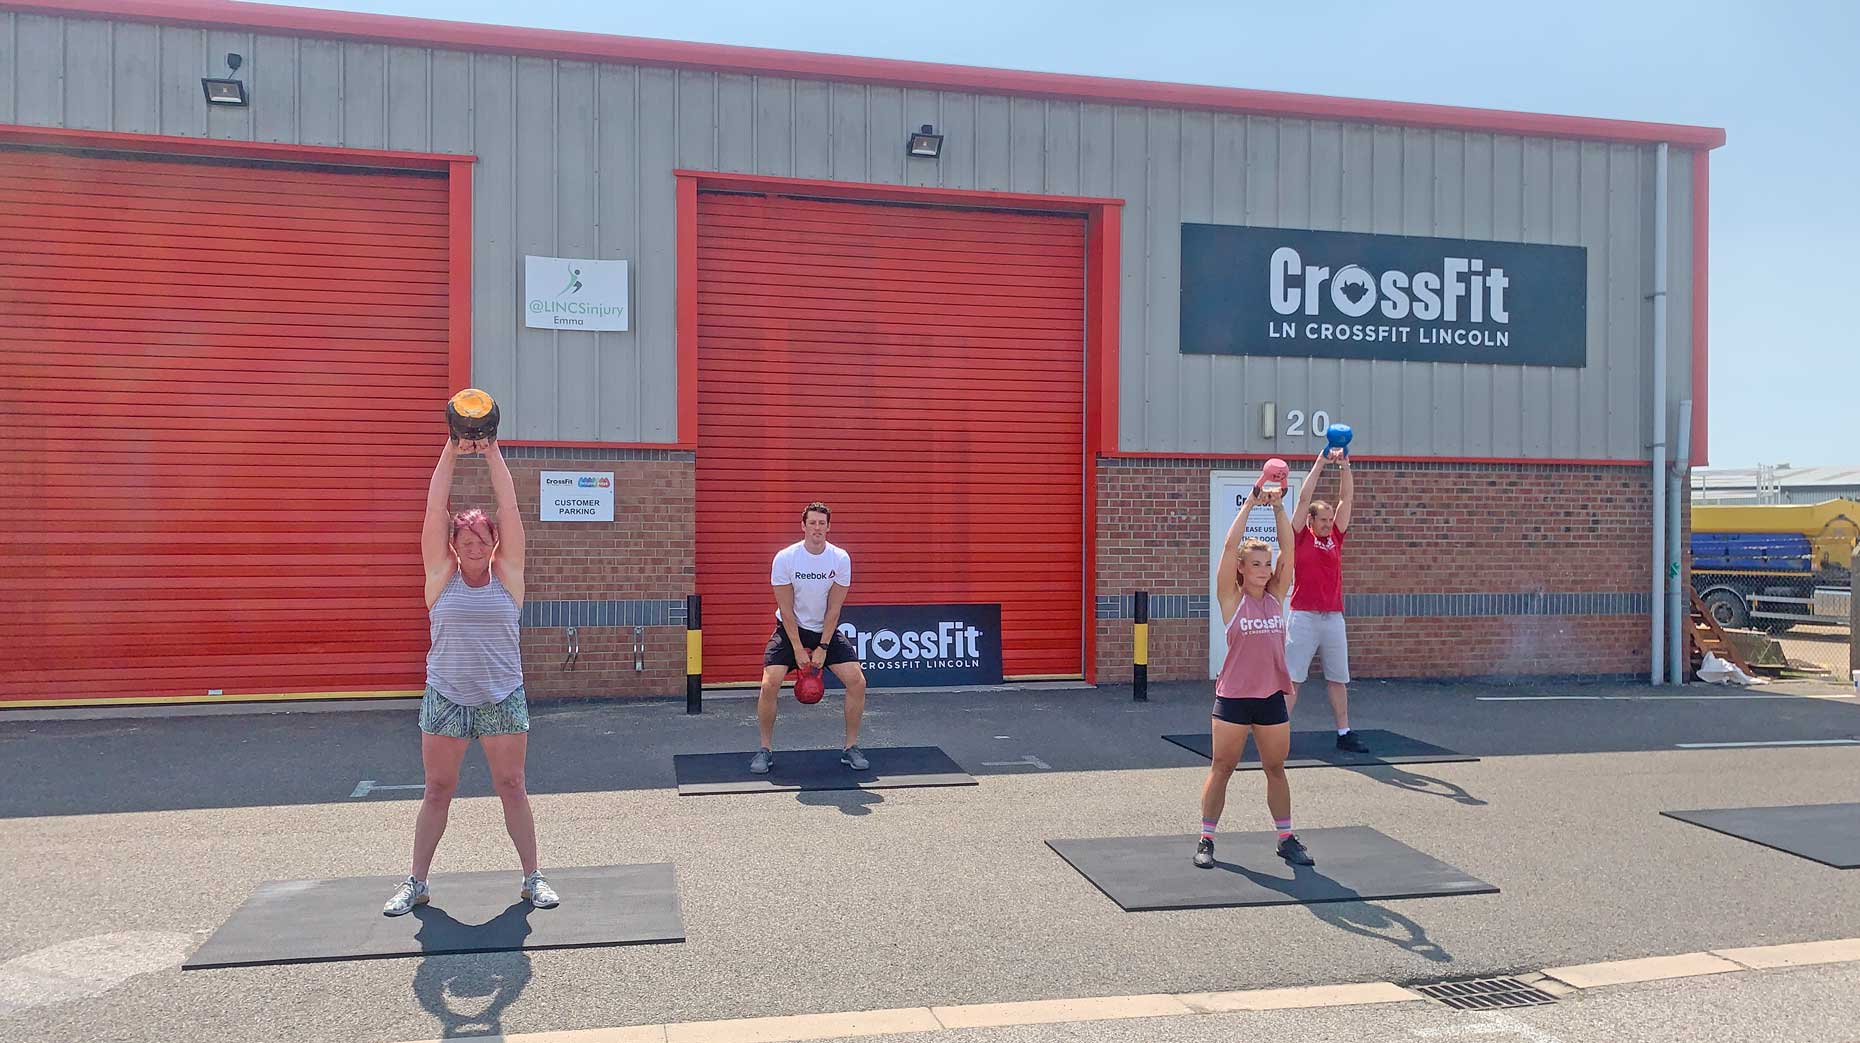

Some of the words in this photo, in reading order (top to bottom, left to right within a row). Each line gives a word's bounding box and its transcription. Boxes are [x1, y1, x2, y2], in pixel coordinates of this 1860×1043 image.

[1269, 247, 1509, 324] CrossFit
[529, 300, 624, 317] @LINCSinjury
[553, 315, 584, 326] Emma
[1269, 322, 1296, 338] LN
[1305, 323, 1410, 343] CROSSFIT
[1419, 327, 1509, 347] LINCOLN
[1286, 409, 1330, 437] 20
[554, 499, 600, 507] CUSTOMER
[795, 571, 827, 580] Reebok
[1240, 615, 1285, 631] CrossFi
[860, 660, 920, 670] CROSSFIT
[926, 660, 979, 669] LINCOLN
